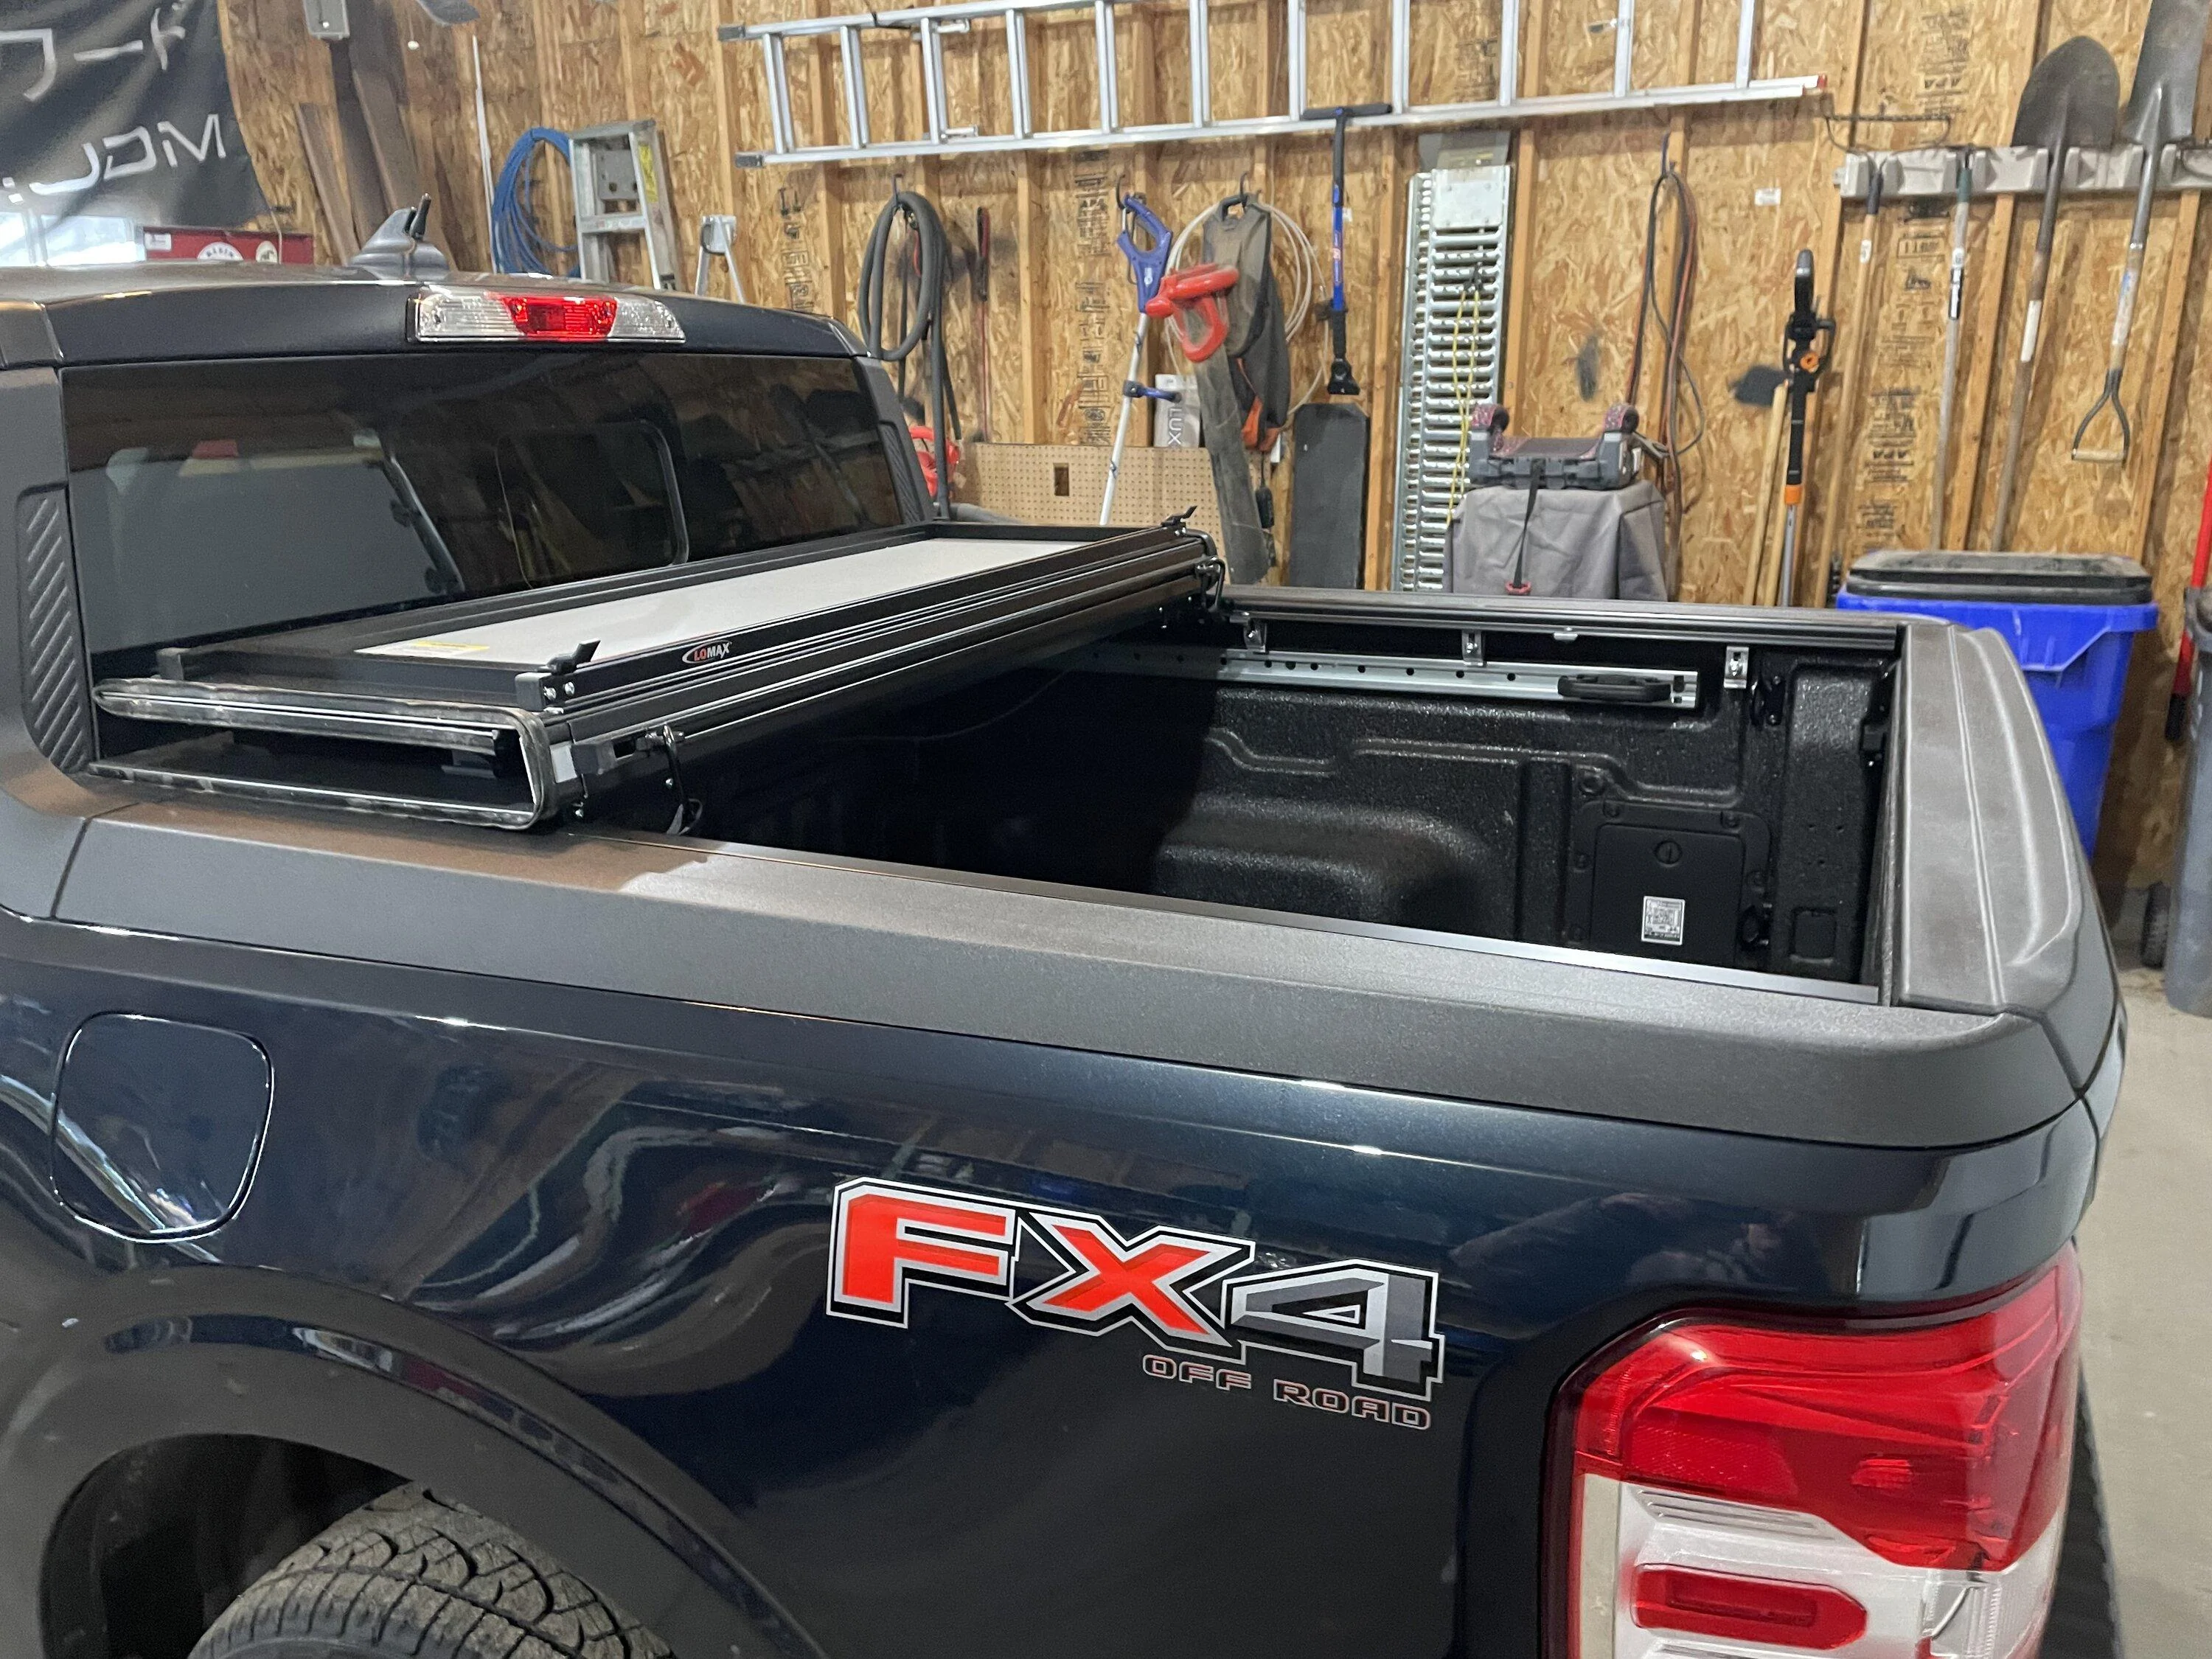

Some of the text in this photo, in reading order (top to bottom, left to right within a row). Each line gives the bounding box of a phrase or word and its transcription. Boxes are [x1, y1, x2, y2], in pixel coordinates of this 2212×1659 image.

[693, 642, 730, 662] LOMAX
[826, 1177, 1446, 1401] FX4
[1142, 1354, 1431, 1430] OFF ROAD
